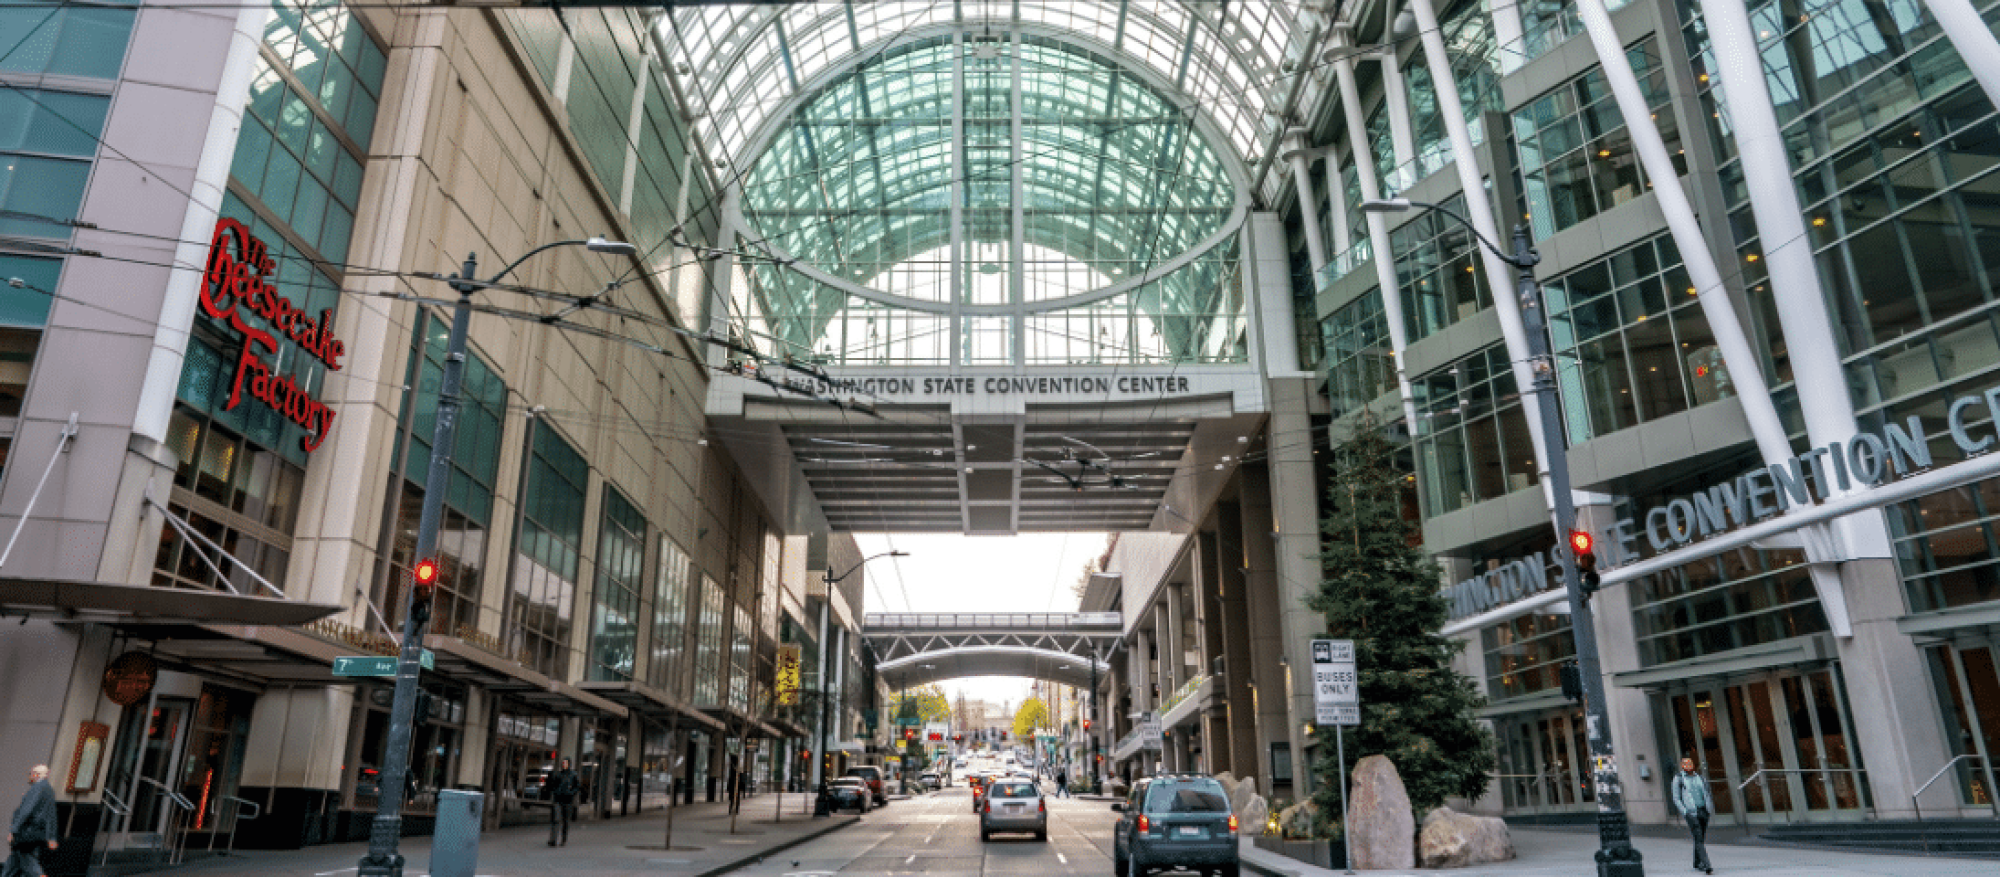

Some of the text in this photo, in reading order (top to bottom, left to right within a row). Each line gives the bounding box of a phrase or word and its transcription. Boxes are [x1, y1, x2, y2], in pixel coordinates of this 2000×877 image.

[249, 235, 277, 277] The
[200, 216, 345, 371] Cheesecake
[226, 312, 337, 453] Factory
[923, 377, 976, 394] STATE
[983, 377, 1108, 394] CONVENTION
[1117, 376, 1190, 393] CENTER
[1645, 414, 1934, 552] CONVENTION
[1316, 671, 1353, 682] BUSES
[1322, 683, 1350, 695] ONLY
